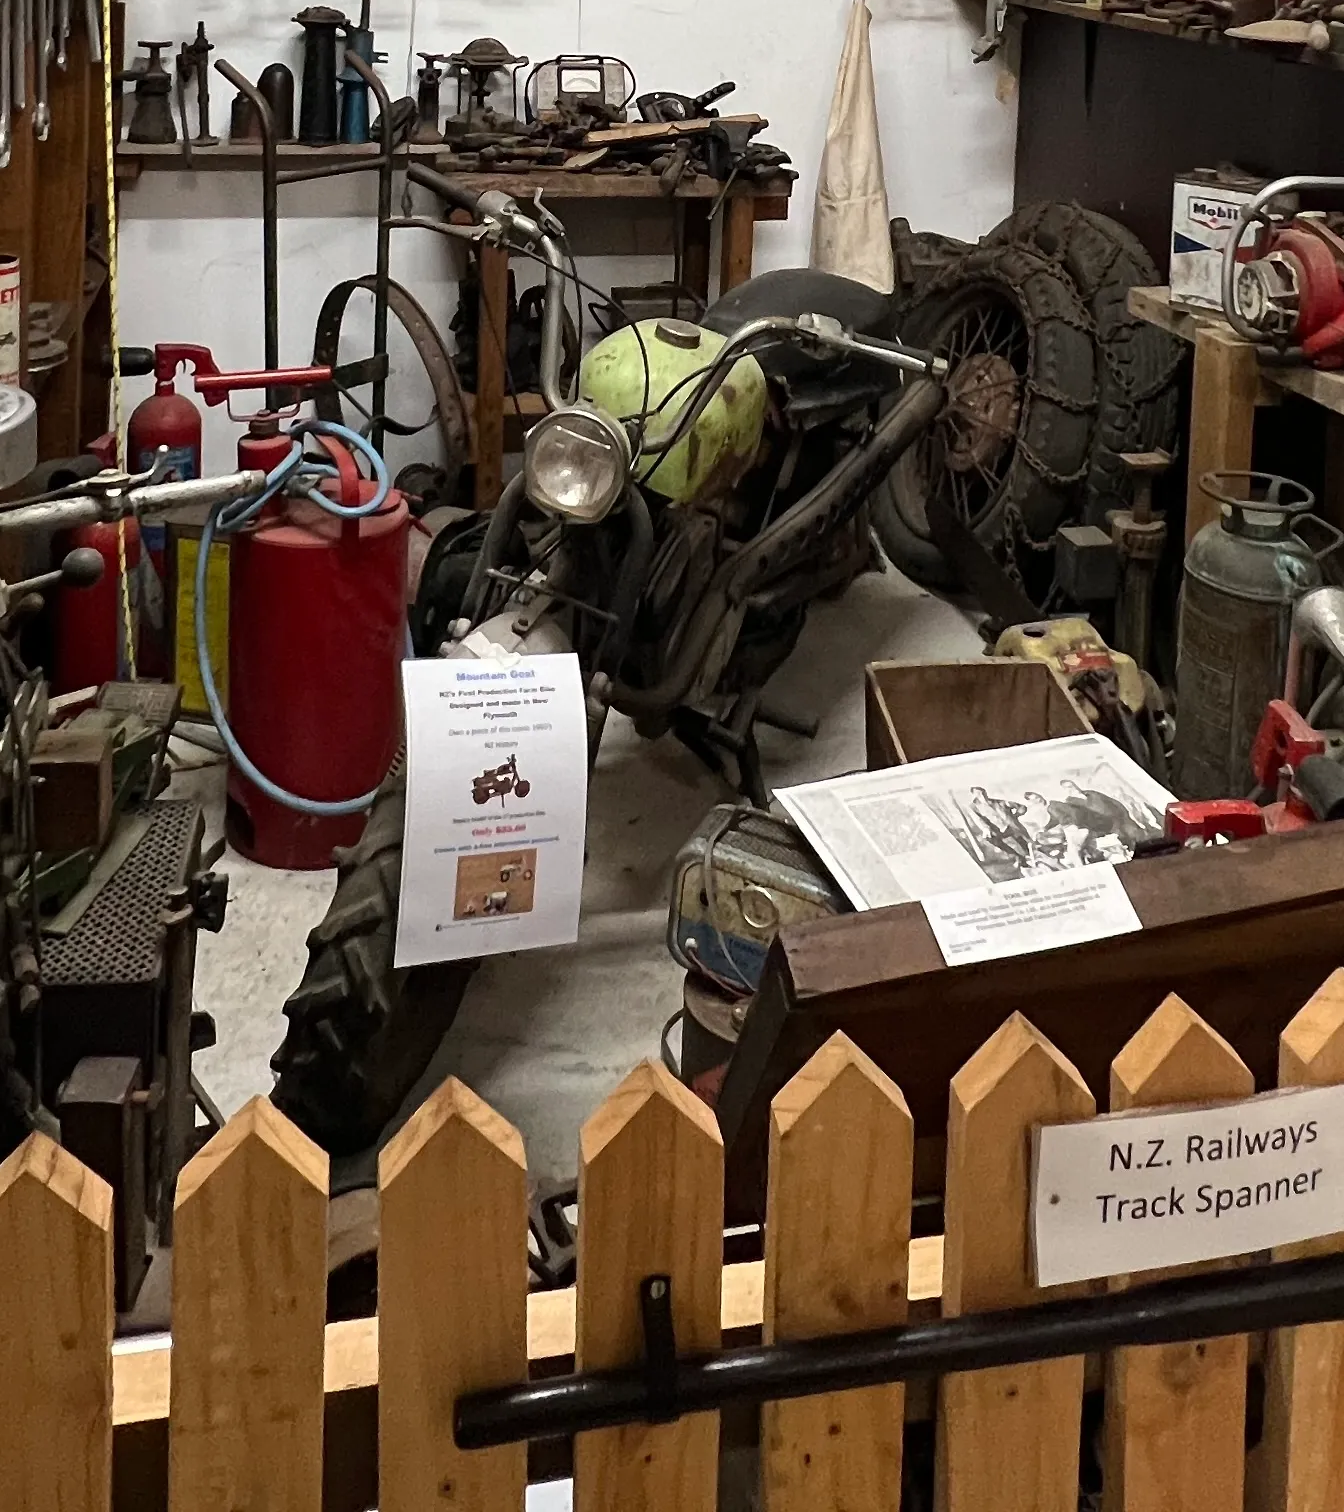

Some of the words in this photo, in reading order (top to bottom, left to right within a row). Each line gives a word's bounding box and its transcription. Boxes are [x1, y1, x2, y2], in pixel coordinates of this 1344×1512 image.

[1193, 202, 1239, 221] Mobil
[456, 672, 507, 681] Mountain
[509, 669, 536, 679] Goat
[1108, 1138, 1175, 1173] N.Z.
[1187, 1116, 1319, 1167] Railways
[1096, 1184, 1185, 1225] Track
[1194, 1162, 1324, 1218] Spanner
